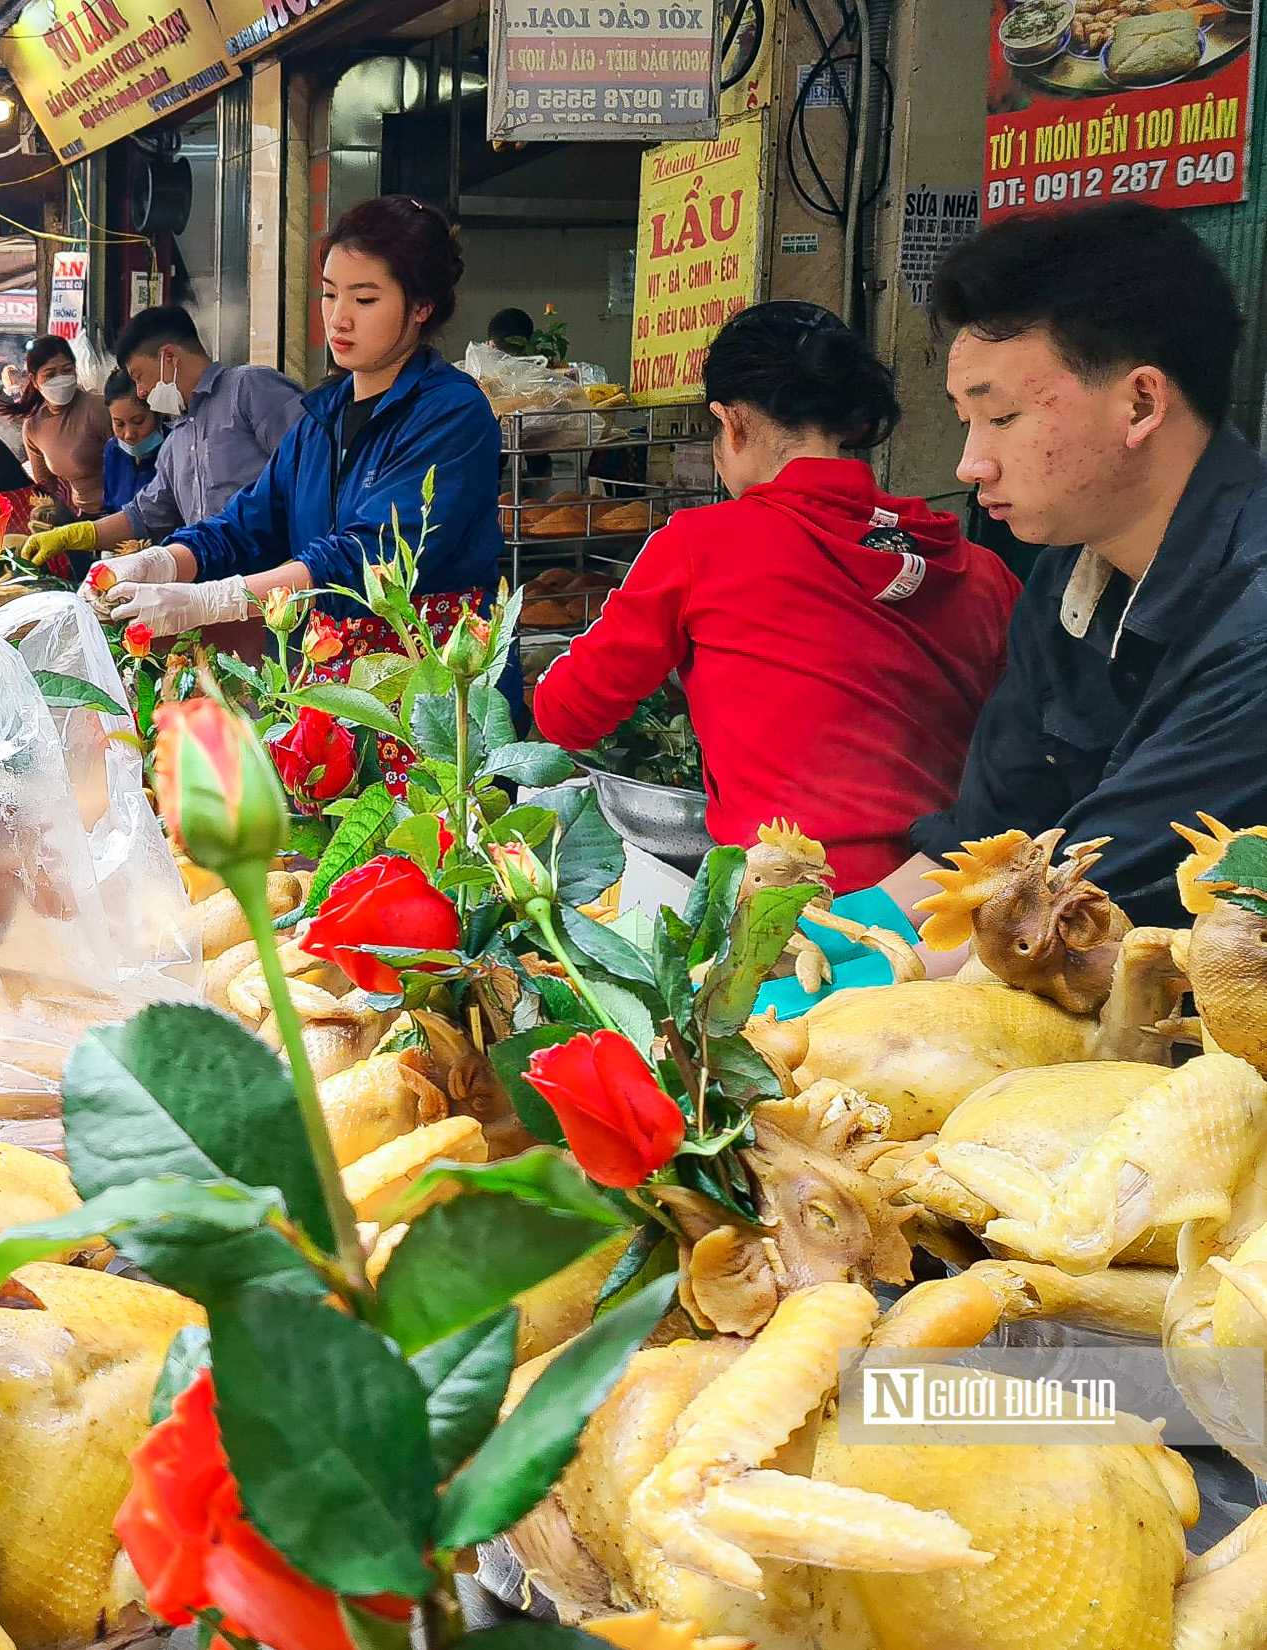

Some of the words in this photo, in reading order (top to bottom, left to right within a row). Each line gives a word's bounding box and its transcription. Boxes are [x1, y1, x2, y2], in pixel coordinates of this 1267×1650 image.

[990, 125, 1014, 171] TỪ
[1019, 131, 1027, 166] 1
[1034, 116, 1081, 164] MÓN
[1087, 103, 1130, 157] ĐẾN
[1135, 108, 1174, 150] 100
[1179, 92, 1239, 144] MÂM
[652, 151, 697, 180] Hoàng
[988, 178, 1026, 209] ĐT:
[1034, 168, 1103, 203] 0912
[1110, 159, 1167, 194] 287
[1176, 151, 1235, 188] 640
[650, 175, 744, 260] LẨU
[905, 183, 938, 216] SỬA
[943, 190, 979, 217] NHÀ
[648, 272, 661, 303] VỊT
[668, 262, 680, 294] GÀ
[688, 260, 712, 289] CHIM
[720, 246, 740, 282] ẾCH
[637, 309, 650, 340] BÒ
[657, 304, 678, 336] RIÊU
[679, 304, 698, 331] CUA
[699, 293, 726, 328] SƯỜN
[631, 347, 651, 393] XÔI
